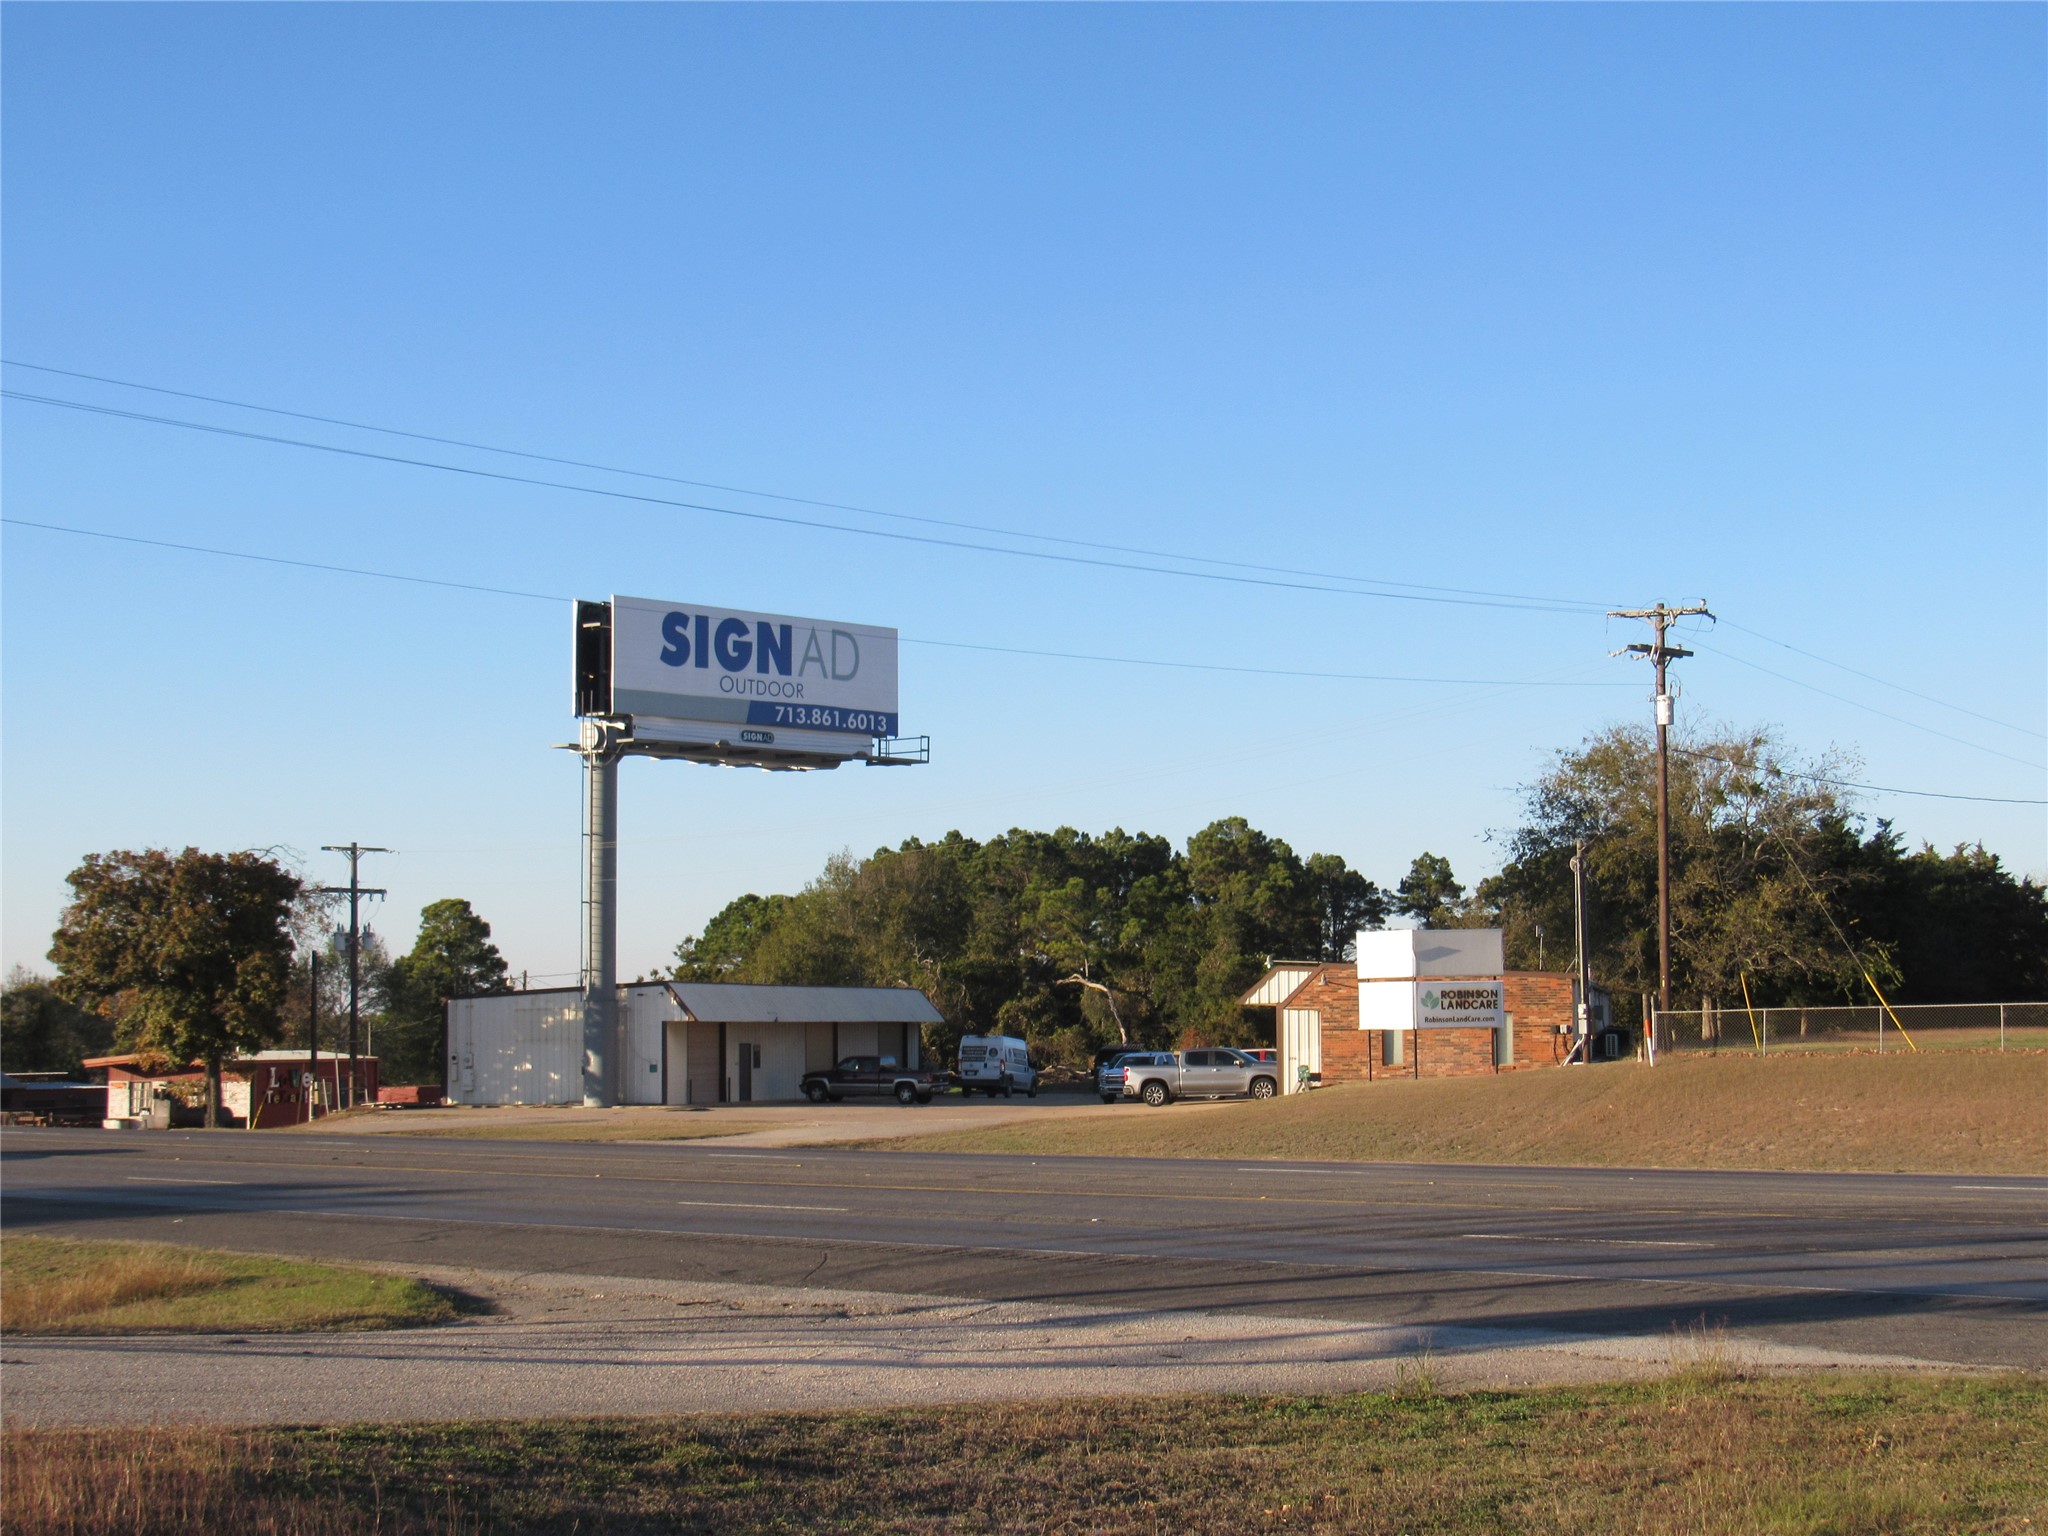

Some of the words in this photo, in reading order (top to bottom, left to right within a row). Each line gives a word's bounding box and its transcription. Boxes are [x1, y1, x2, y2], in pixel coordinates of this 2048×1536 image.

[719, 674, 805, 699] OUTDOOR
[775, 706, 888, 732] 713.861.6013
[1440, 989, 1498, 999] ROBINSON
[1440, 1000, 1498, 1009] LANDCARE
